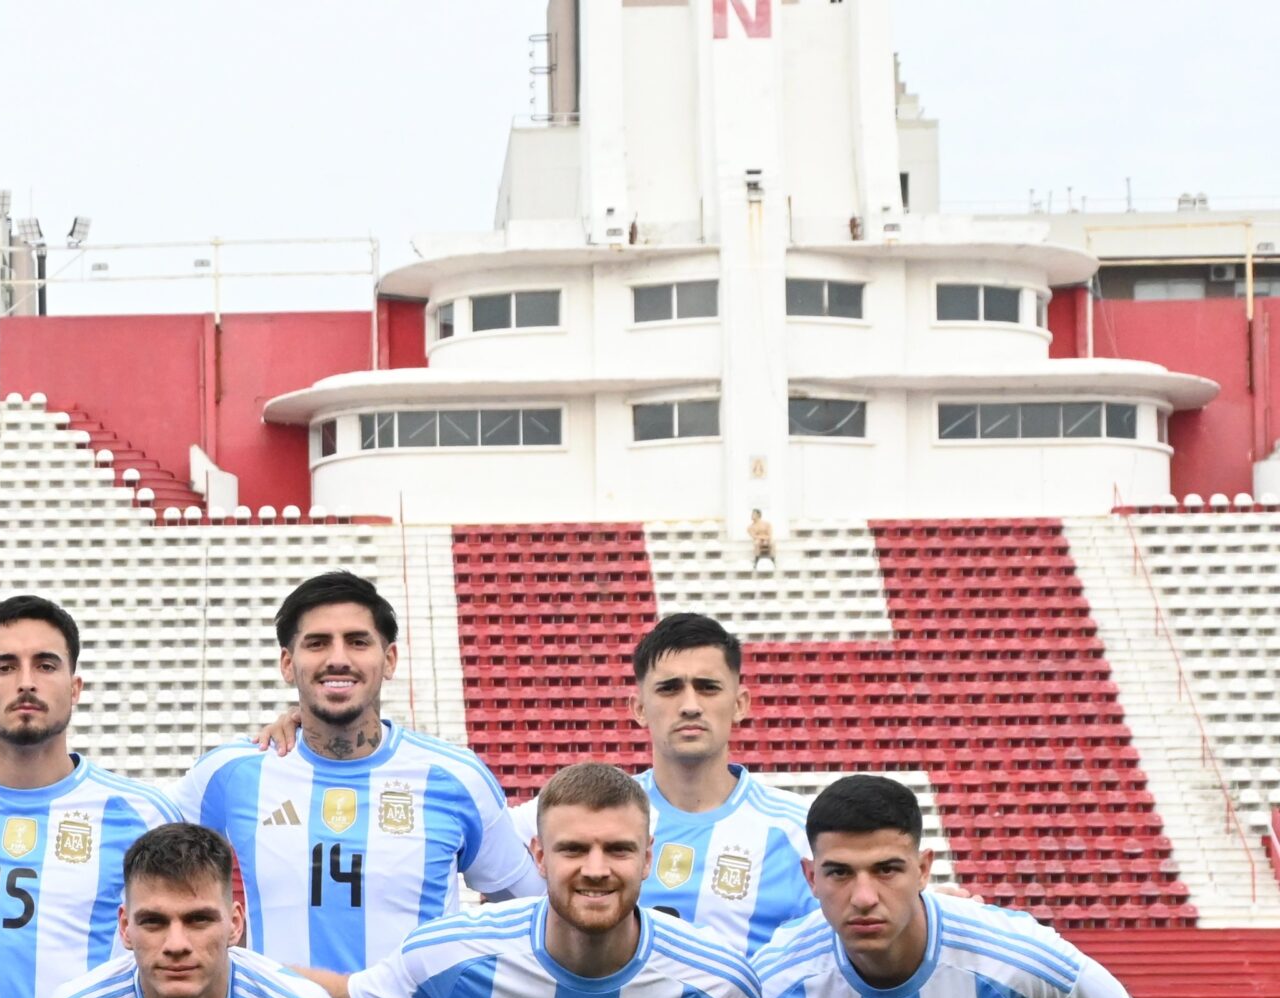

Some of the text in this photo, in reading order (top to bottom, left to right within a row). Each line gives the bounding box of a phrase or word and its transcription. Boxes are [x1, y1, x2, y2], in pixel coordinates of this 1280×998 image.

[387, 804, 406, 823] AFA
[64, 833, 83, 852] AFA
[311, 842, 363, 908] 14
